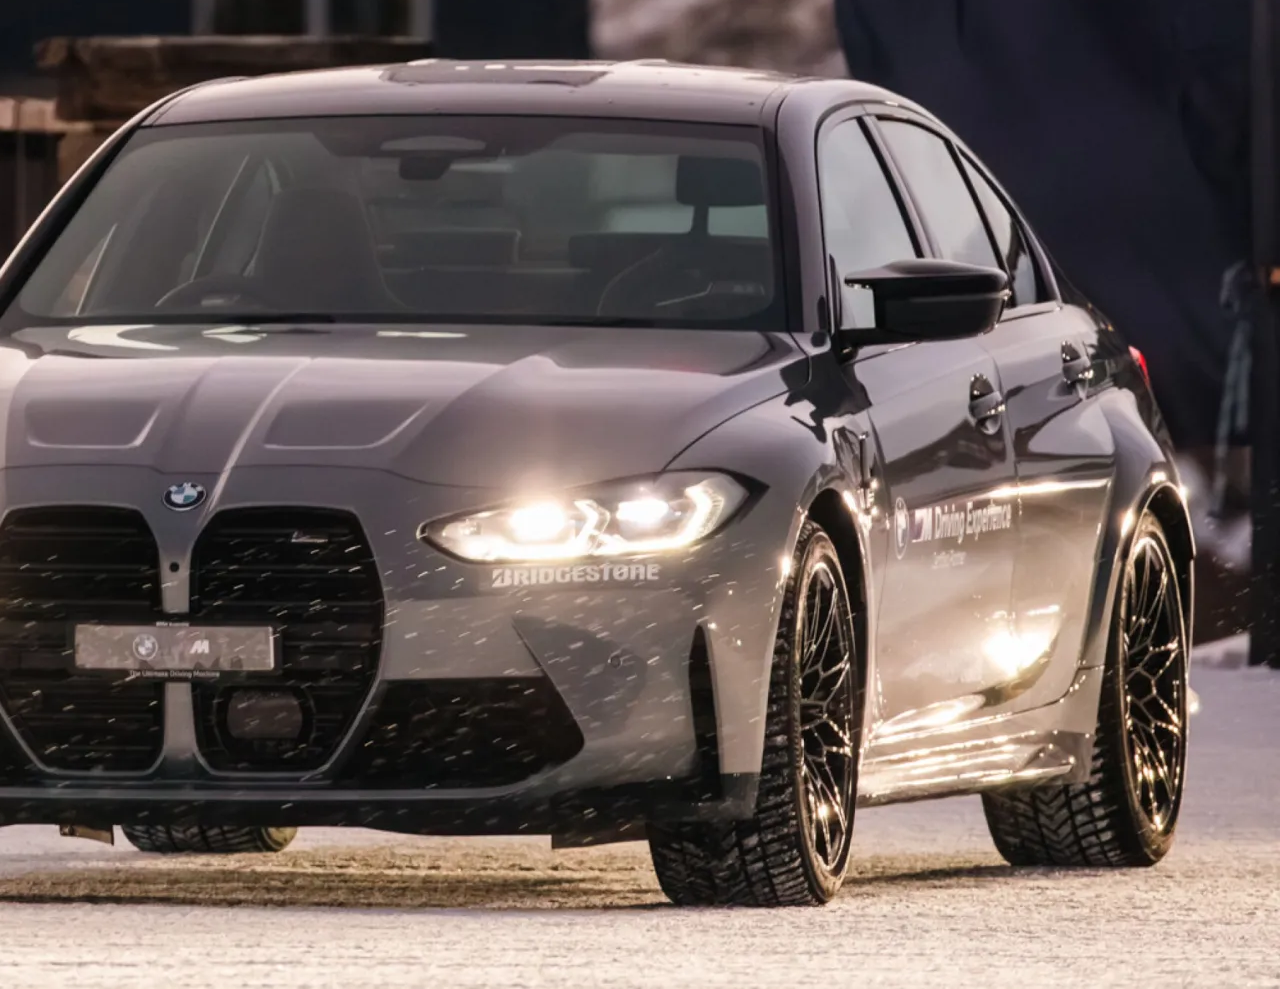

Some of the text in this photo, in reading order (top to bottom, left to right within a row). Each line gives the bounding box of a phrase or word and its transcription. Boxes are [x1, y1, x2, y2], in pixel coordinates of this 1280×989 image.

[934, 503, 965, 544] Driving
[966, 501, 1012, 541] Experience
[492, 563, 661, 588] BRIDGESTONE
